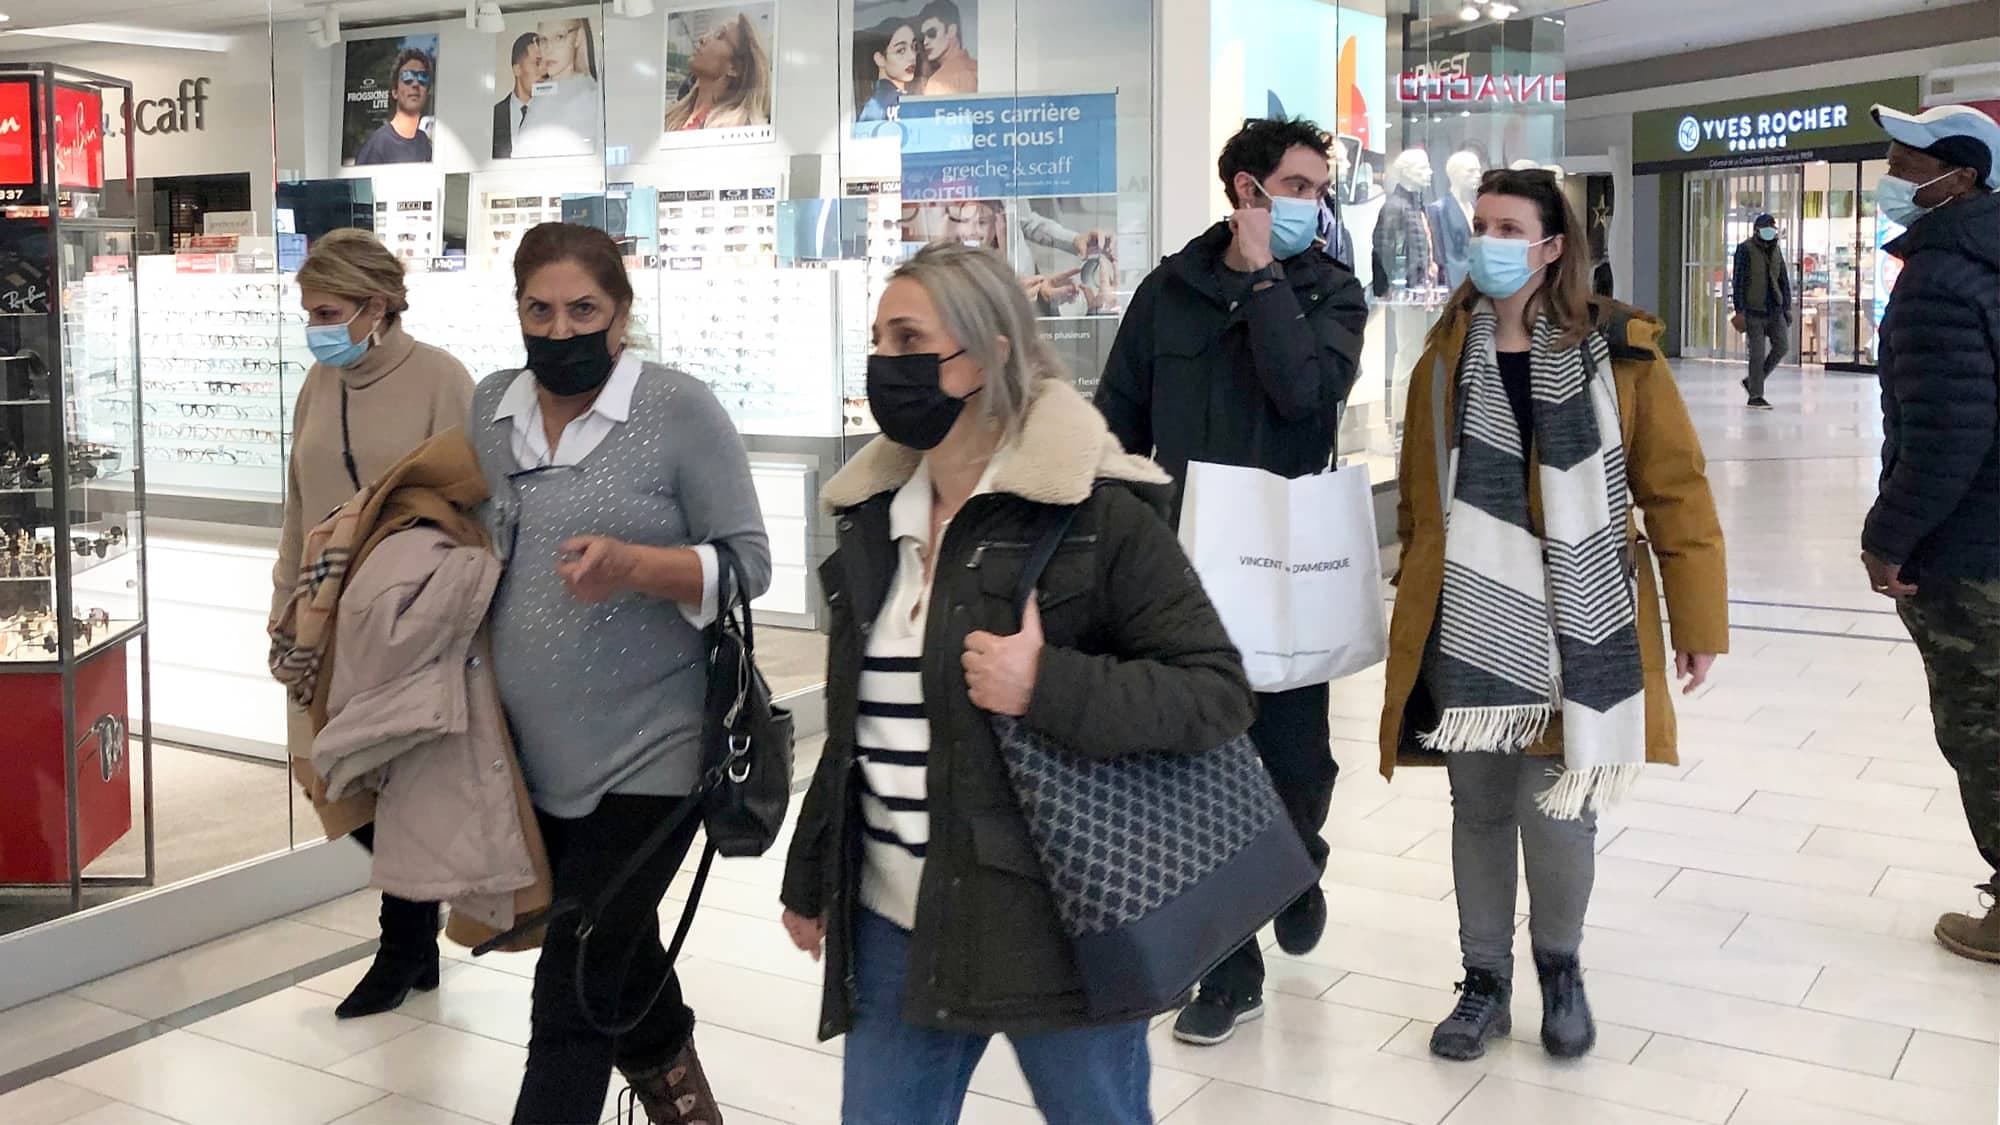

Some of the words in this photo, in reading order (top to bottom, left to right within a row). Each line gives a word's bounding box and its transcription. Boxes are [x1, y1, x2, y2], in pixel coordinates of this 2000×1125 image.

[373, 99, 389, 108] LITE
[935, 107, 995, 126] Faites
[1000, 102, 1080, 124] carrière
[1702, 115, 1752, 140] YVES
[1758, 104, 1848, 135] ROCHER
[951, 131, 997, 148] avec
[942, 160, 1008, 183] greiche
[1012, 161, 1027, 177] &
[1028, 156, 1073, 175] scaff
[1240, 555, 1283, 570] VINCENT
